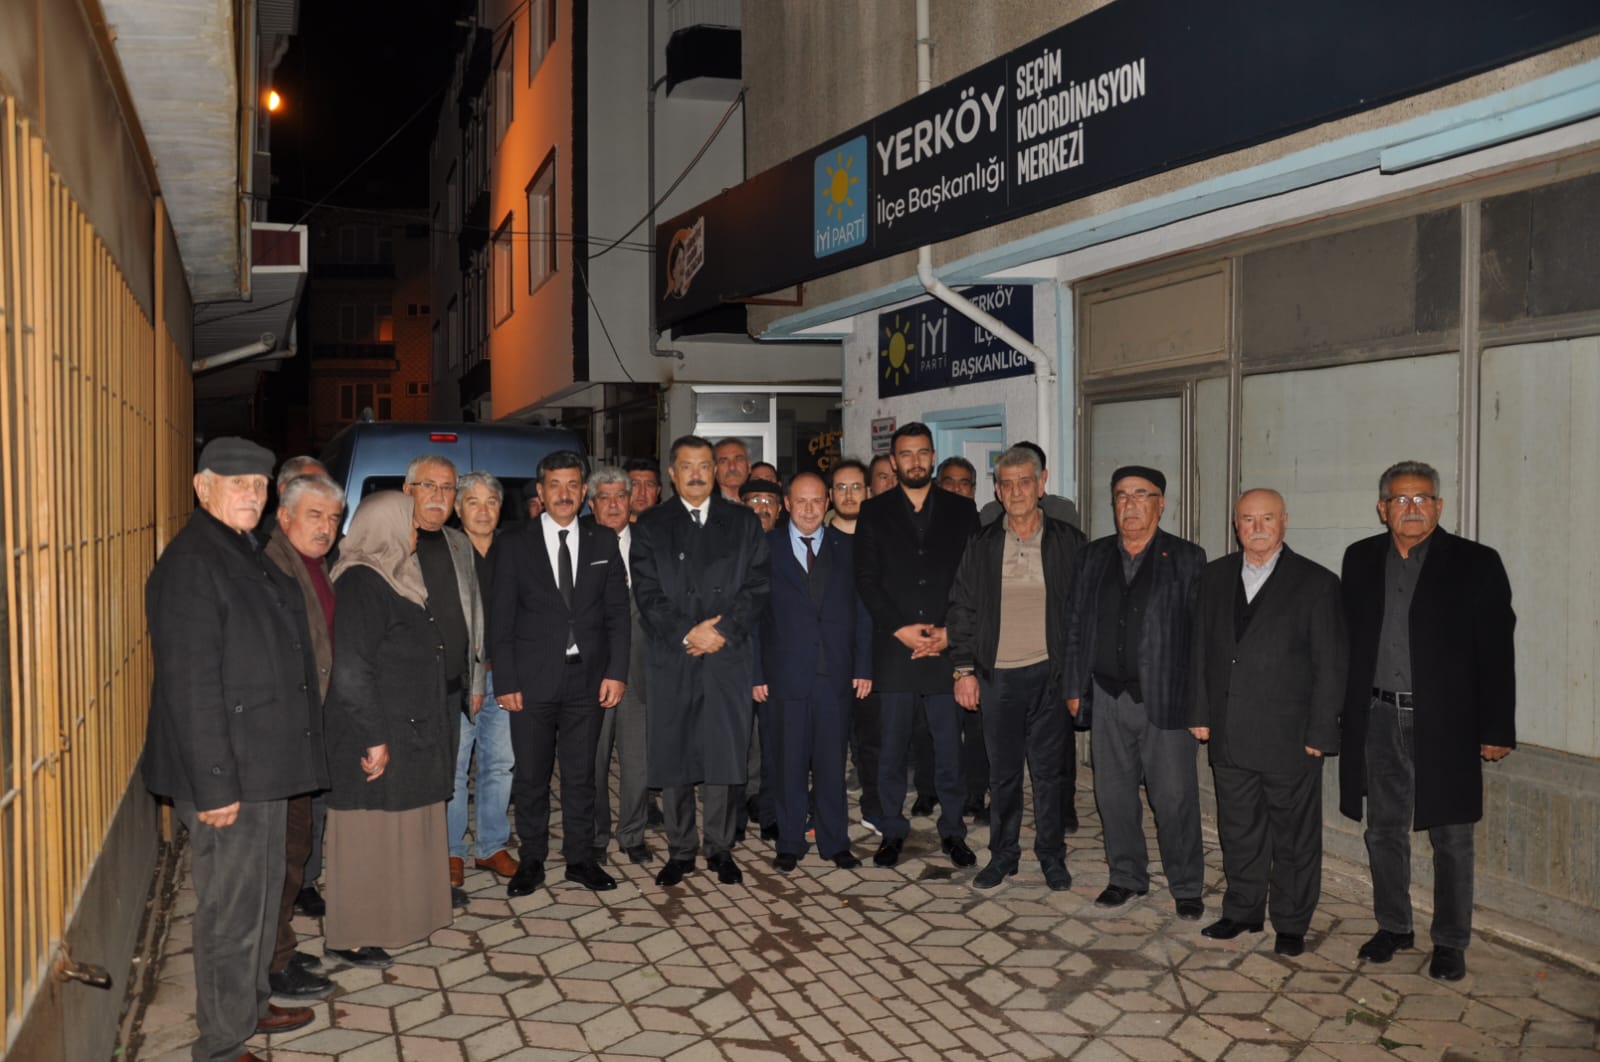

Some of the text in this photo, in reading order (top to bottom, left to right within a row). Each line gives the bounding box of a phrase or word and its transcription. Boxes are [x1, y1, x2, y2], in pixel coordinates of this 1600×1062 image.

[1016, 48, 1062, 100] SEÇİM
[1016, 57, 1146, 143] KOORDİNASYON
[876, 85, 1005, 176] YERKÖY
[1017, 122, 1084, 185] MERKEZİ
[877, 155, 1005, 228] İlçe Başkanlığı
[816, 213, 865, 253] İYİ PARTİ
[921, 307, 948, 358] İYİ
[920, 354, 948, 372] PARTİ
